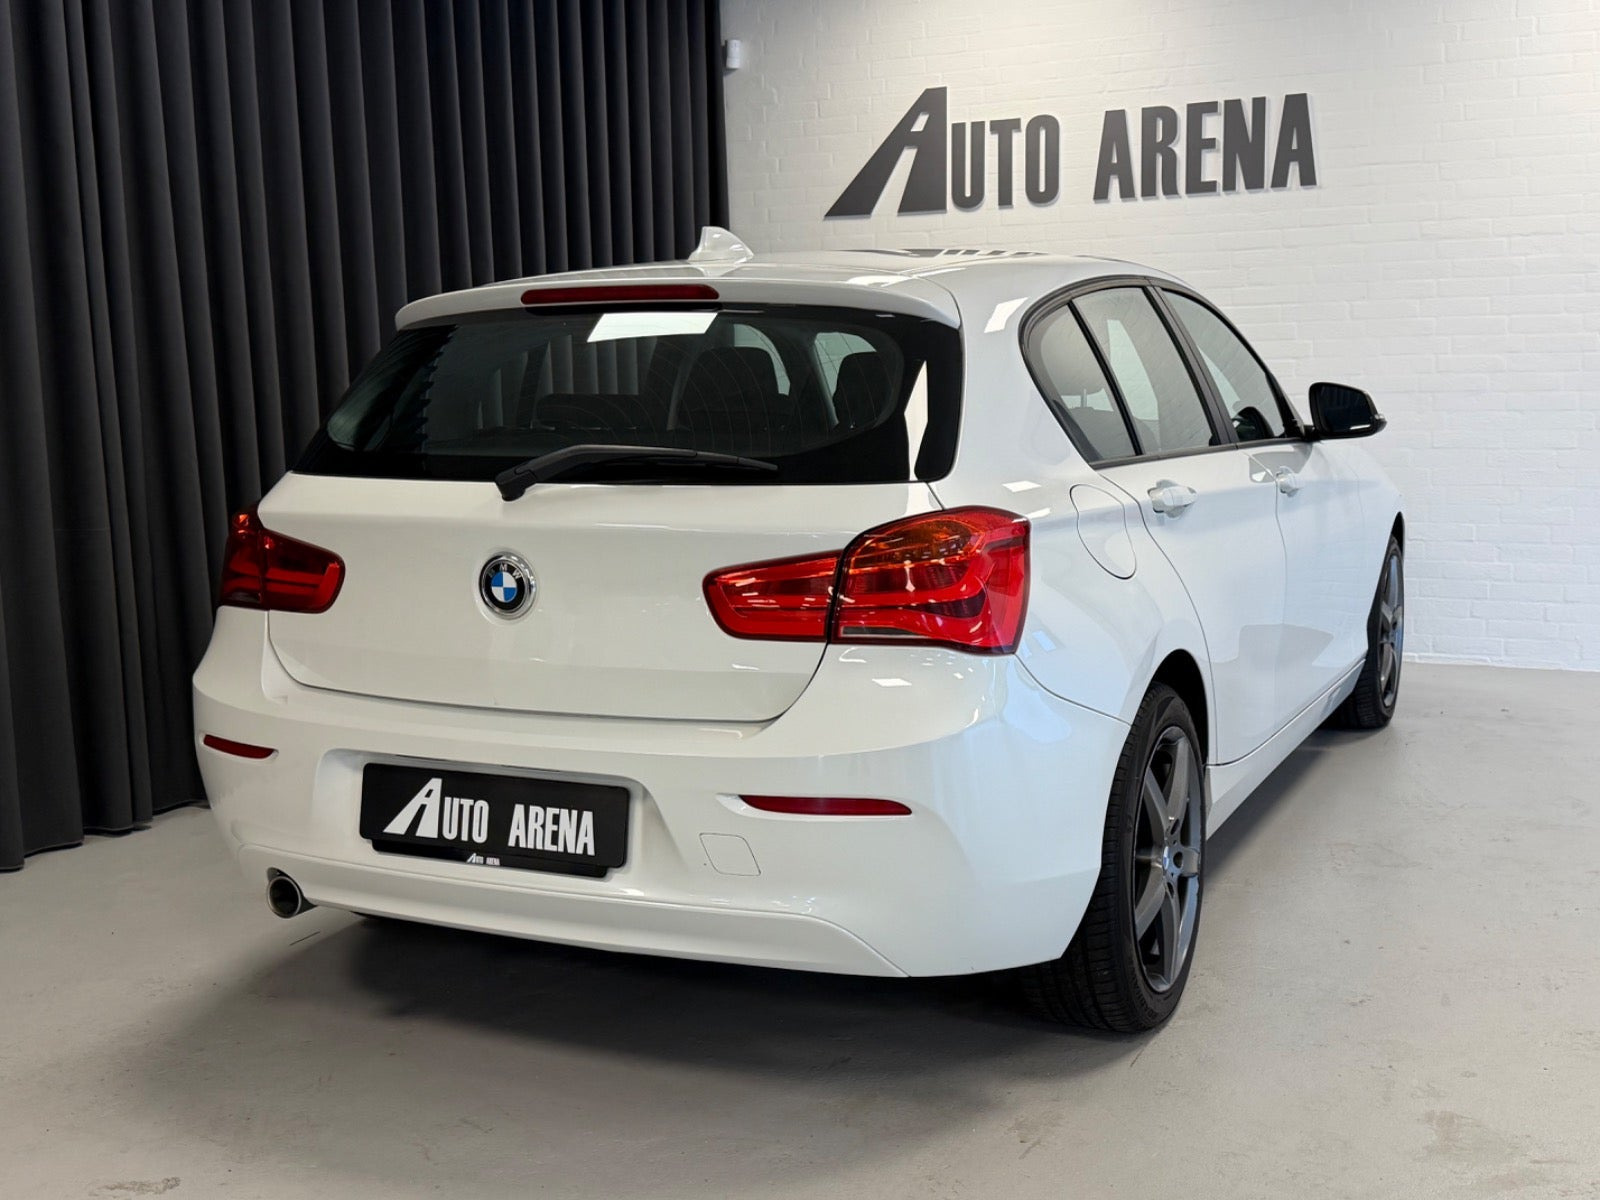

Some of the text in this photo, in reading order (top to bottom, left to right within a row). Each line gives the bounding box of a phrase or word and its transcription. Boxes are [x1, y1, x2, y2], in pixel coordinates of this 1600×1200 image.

[824, 86, 1317, 219] AUTO ARENA
[383, 777, 596, 856] AUTO ARENA
